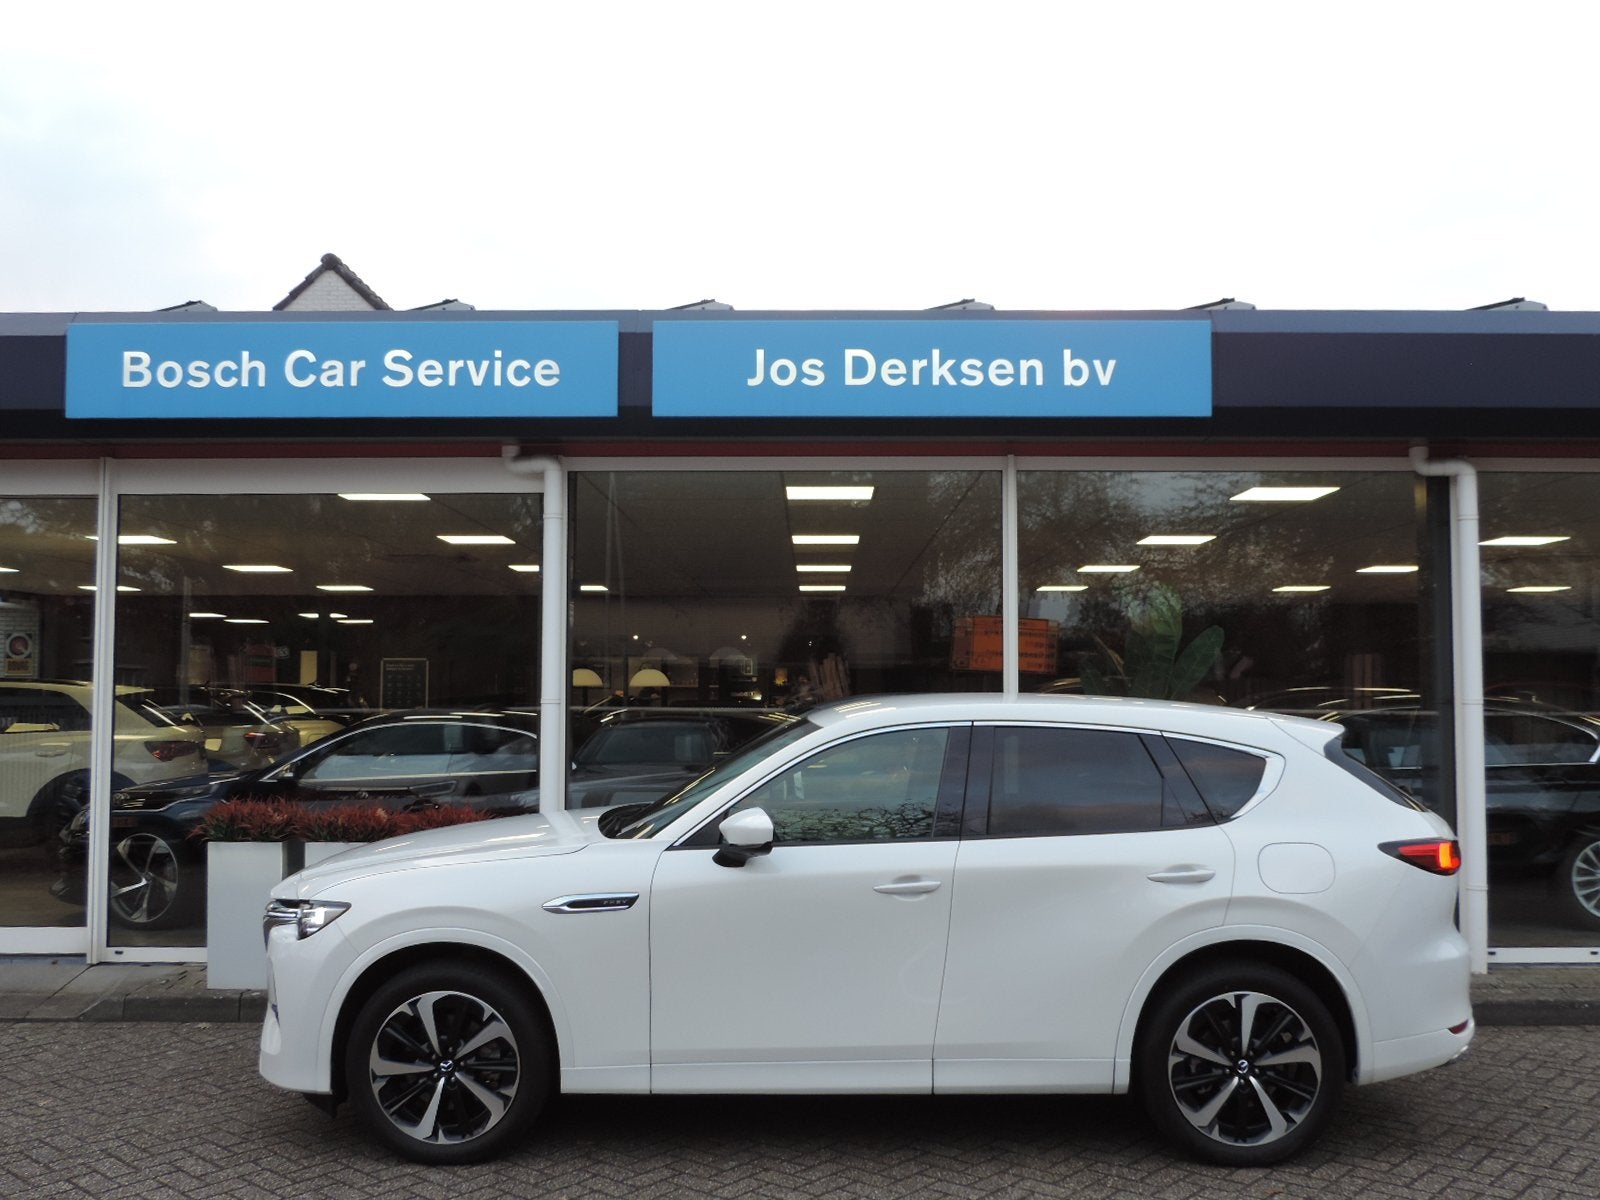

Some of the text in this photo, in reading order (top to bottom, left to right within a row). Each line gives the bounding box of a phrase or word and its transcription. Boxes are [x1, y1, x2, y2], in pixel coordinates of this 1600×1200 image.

[121, 349, 560, 389] Bosch Car Service
[747, 348, 1117, 387] Jos Derksen bv
